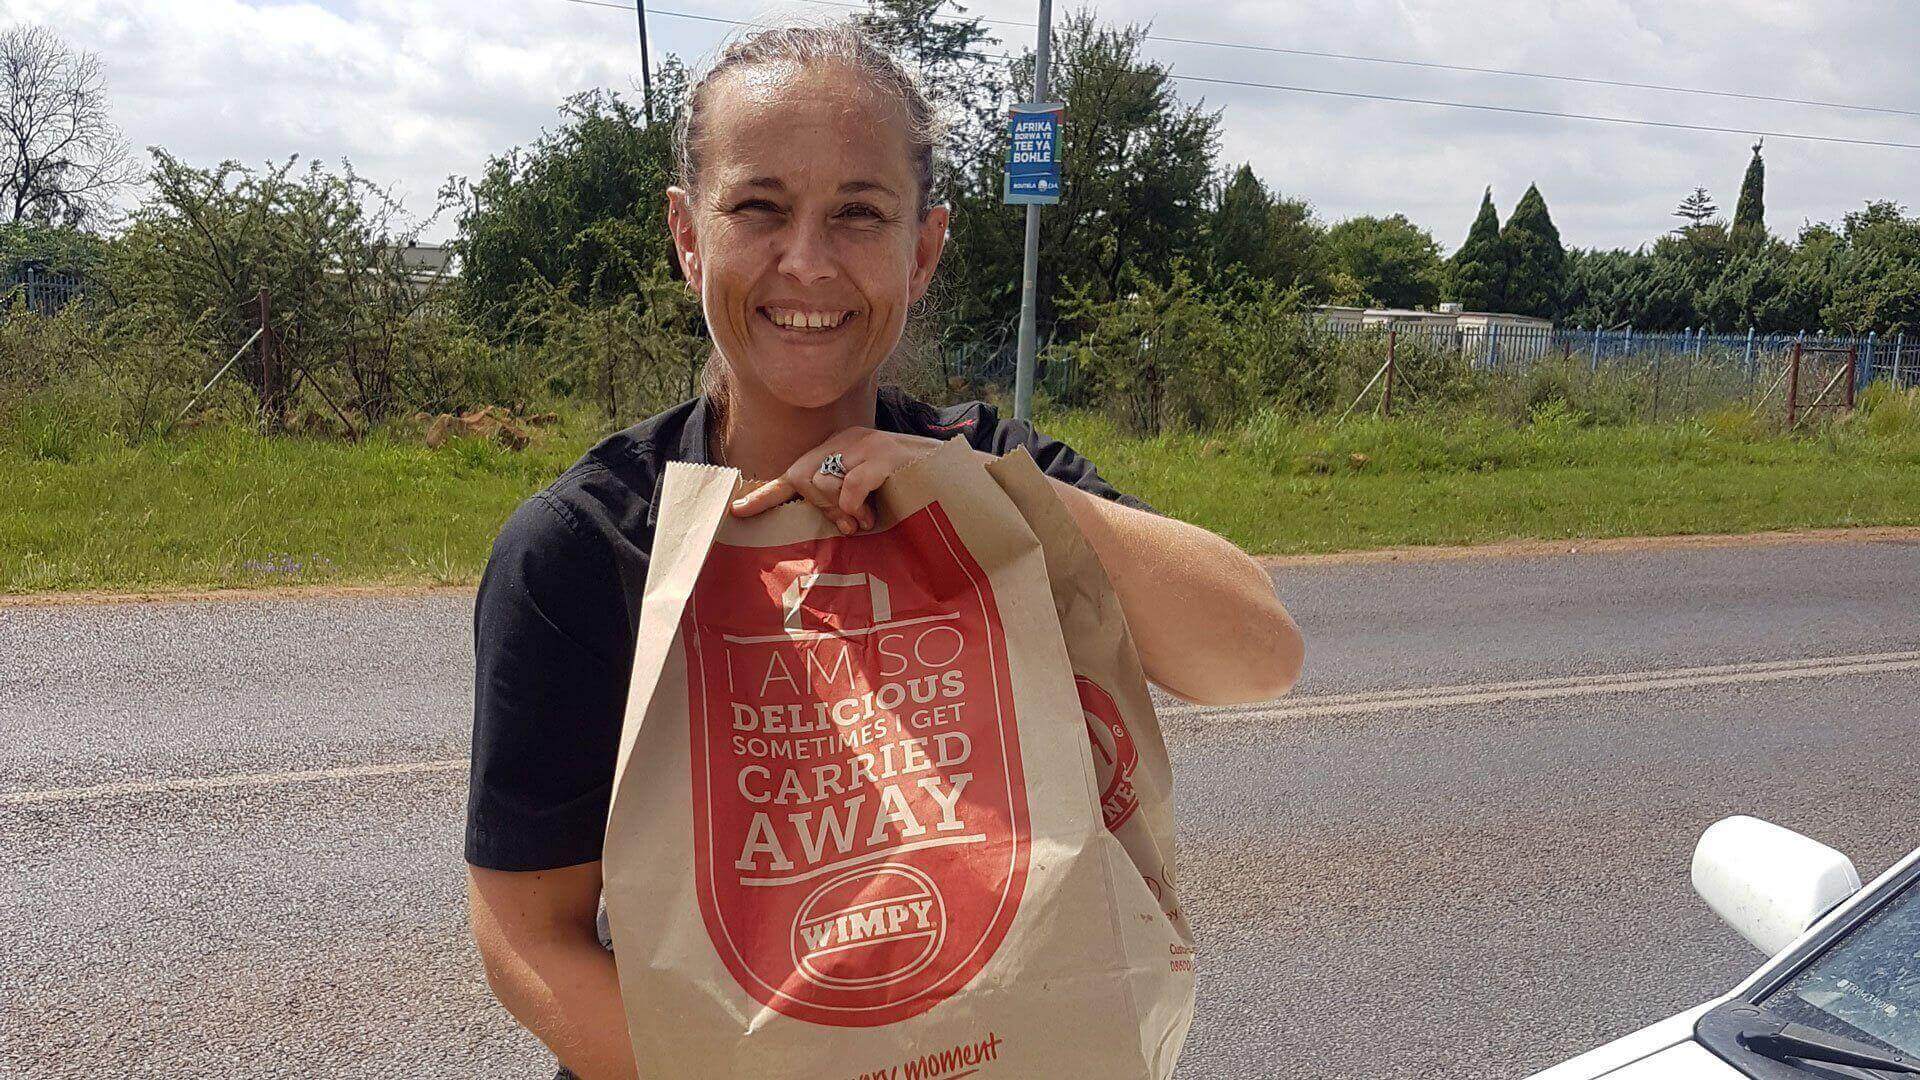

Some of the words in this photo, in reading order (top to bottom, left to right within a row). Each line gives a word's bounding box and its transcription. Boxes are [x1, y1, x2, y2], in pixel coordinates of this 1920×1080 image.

[1014, 142, 1034, 151] TEE
[1036, 141, 1051, 151] YA
[1015, 122, 1052, 132] AFRIKA
[1013, 152, 1051, 163] BOHLE
[725, 648, 734, 694] I
[760, 644, 855, 697] AM
[877, 625, 966, 676] SO
[730, 669, 966, 735] DELICIOUS
[732, 719, 888, 760] SOMETIMES
[910, 702, 966, 729] GET
[737, 731, 973, 806] CARRIED
[734, 772, 974, 872] AWAY
[800, 900, 933, 950] WIMPY
[904, 1032, 1003, 1080] moment
